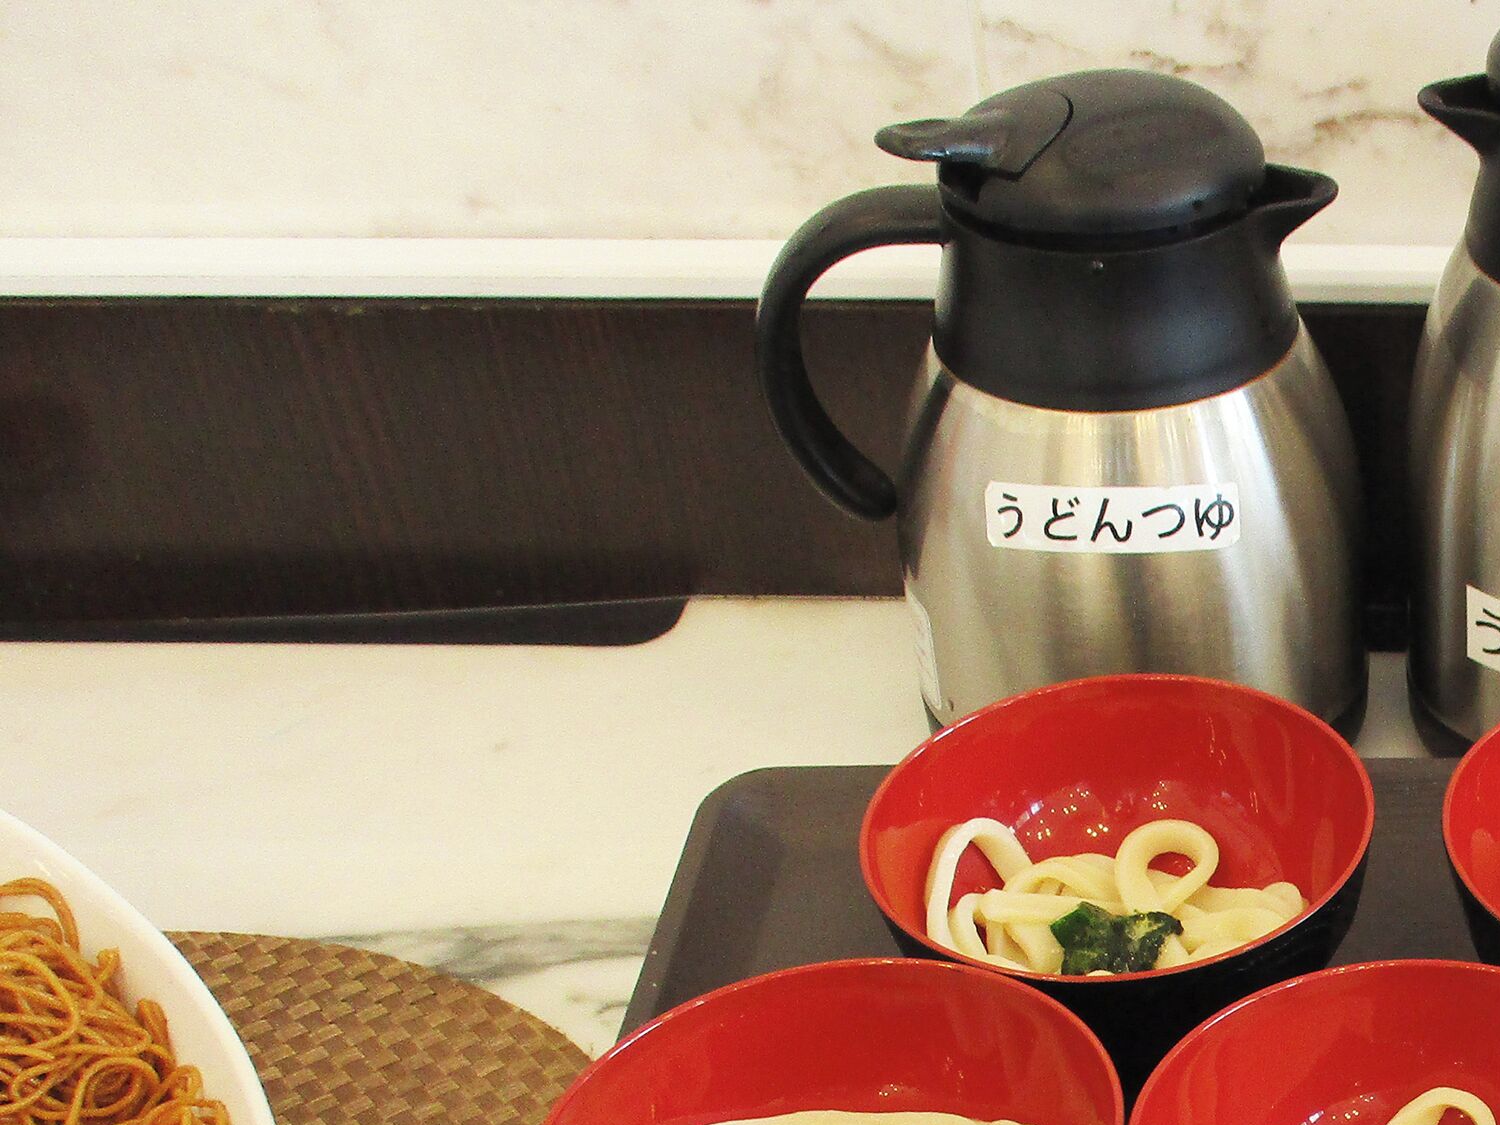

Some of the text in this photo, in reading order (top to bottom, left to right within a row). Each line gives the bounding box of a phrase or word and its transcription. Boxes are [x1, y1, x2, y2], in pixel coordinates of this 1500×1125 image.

[997, 493, 1235, 542] うどんつゆ
